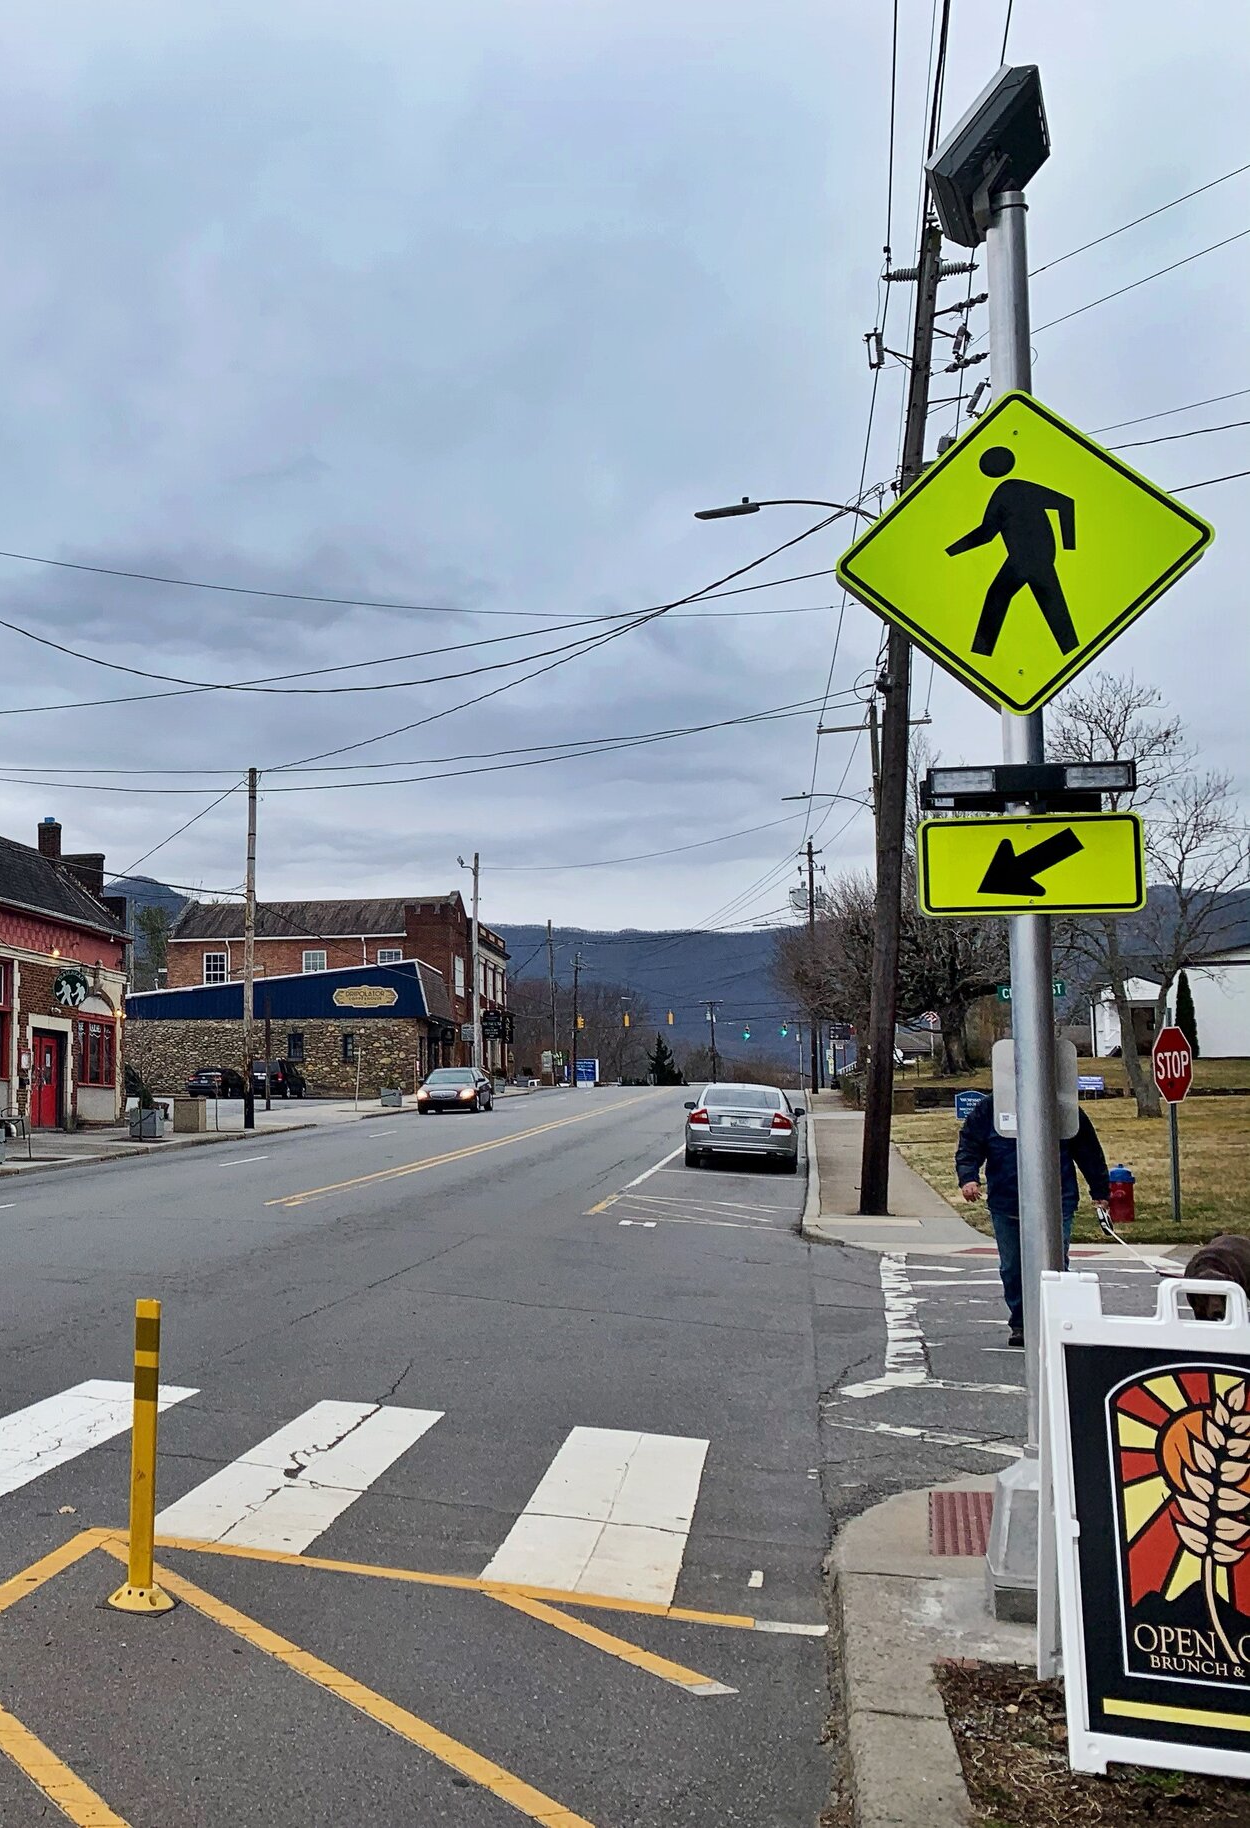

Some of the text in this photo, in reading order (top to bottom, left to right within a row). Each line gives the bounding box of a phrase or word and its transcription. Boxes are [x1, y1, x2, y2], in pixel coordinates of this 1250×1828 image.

[1156, 1050, 1189, 1080] STOP
[1133, 1623, 1216, 1660] OPEN
[1150, 1654, 1246, 1678] BRUNCH &
